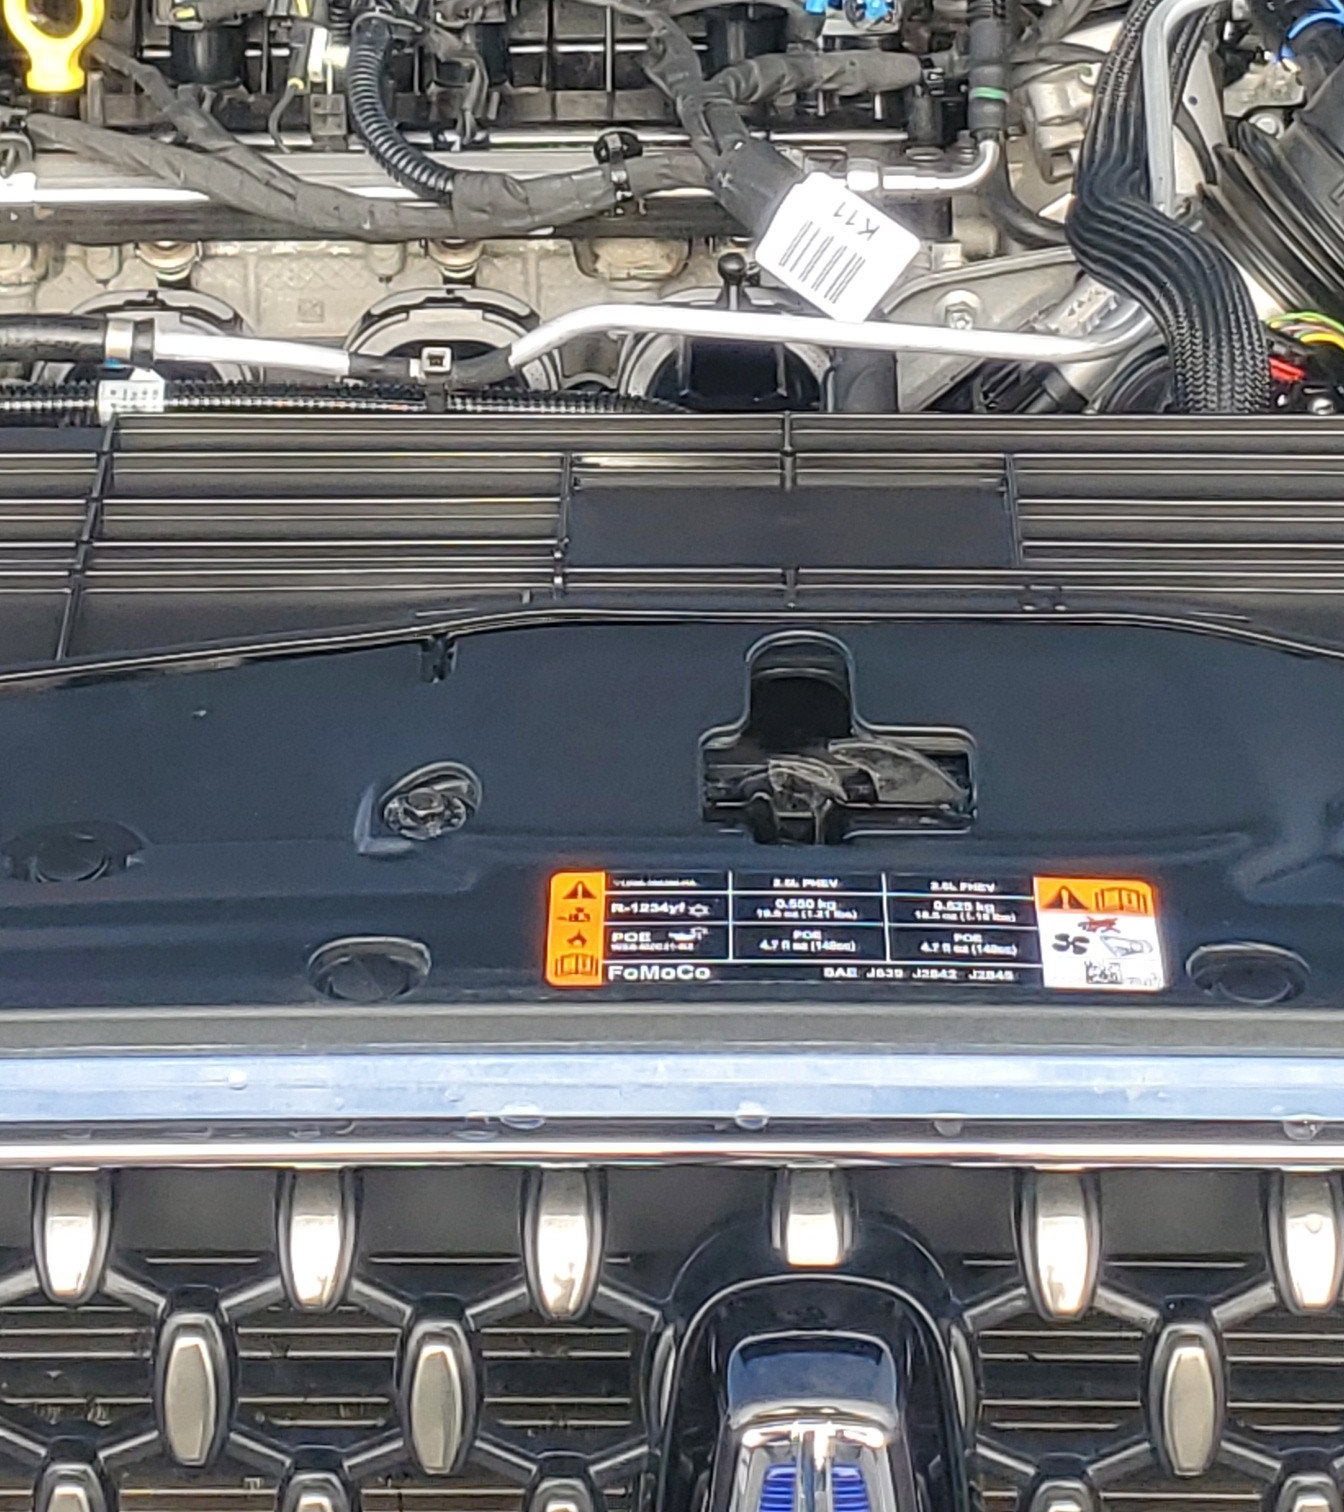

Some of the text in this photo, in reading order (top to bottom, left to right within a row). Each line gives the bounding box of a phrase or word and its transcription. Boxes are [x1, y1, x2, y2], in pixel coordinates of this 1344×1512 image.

[832, 200, 881, 242] K11
[611, 901, 686, 915] R-1234yf
[818, 898, 837, 911] kg
[976, 901, 996, 914] kg
[607, 963, 711, 981] FoMoCo
